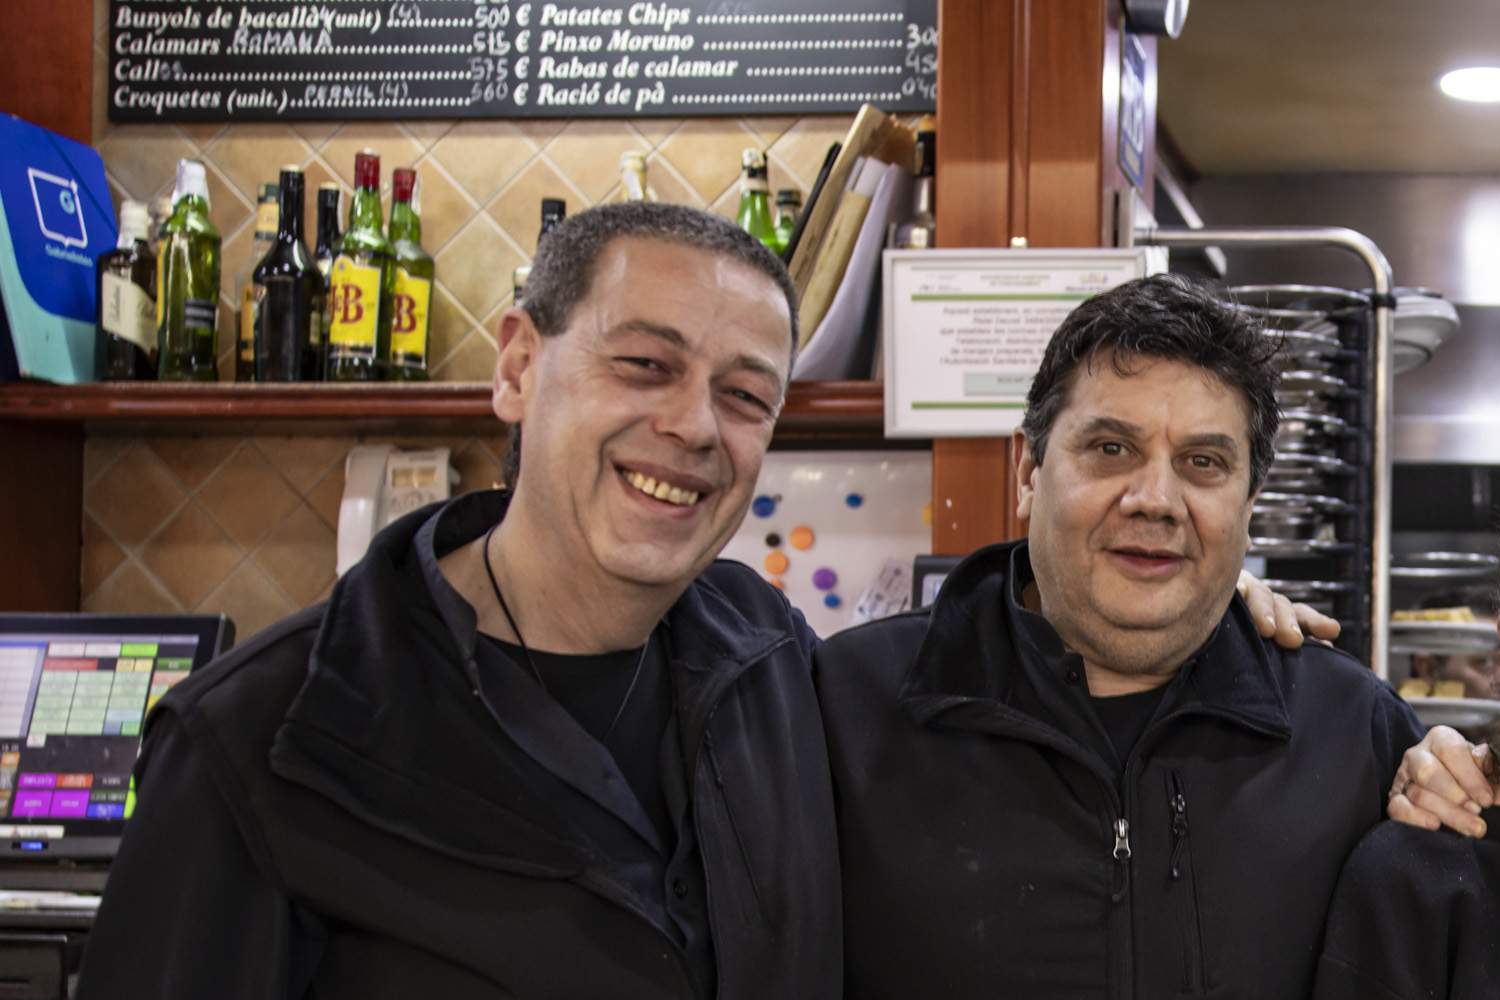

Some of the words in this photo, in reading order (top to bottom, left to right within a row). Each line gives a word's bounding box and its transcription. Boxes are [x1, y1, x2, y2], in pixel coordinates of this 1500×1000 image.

[115, 5, 201, 36] Bunyols
[206, 6, 233, 28] de
[515, 3, 531, 26] €
[540, 3, 623, 26] Patates
[628, 2, 691, 32] Chips
[115, 32, 221, 55] Calamars
[515, 30, 531, 51] €
[539, 29, 603, 51] Pinxo
[606, 29, 695, 51] Moruno
[514, 56, 530, 79] €
[537, 56, 608, 79] Rabas
[612, 55, 640, 78] de
[644, 55, 739, 78] calamar
[114, 85, 221, 115] Croquetes
[227, 88, 288, 114] (unit.)
[513, 83, 529, 106] €
[537, 82, 601, 105] Ració
[604, 82, 631, 105] de
[634, 81, 666, 112] pà
